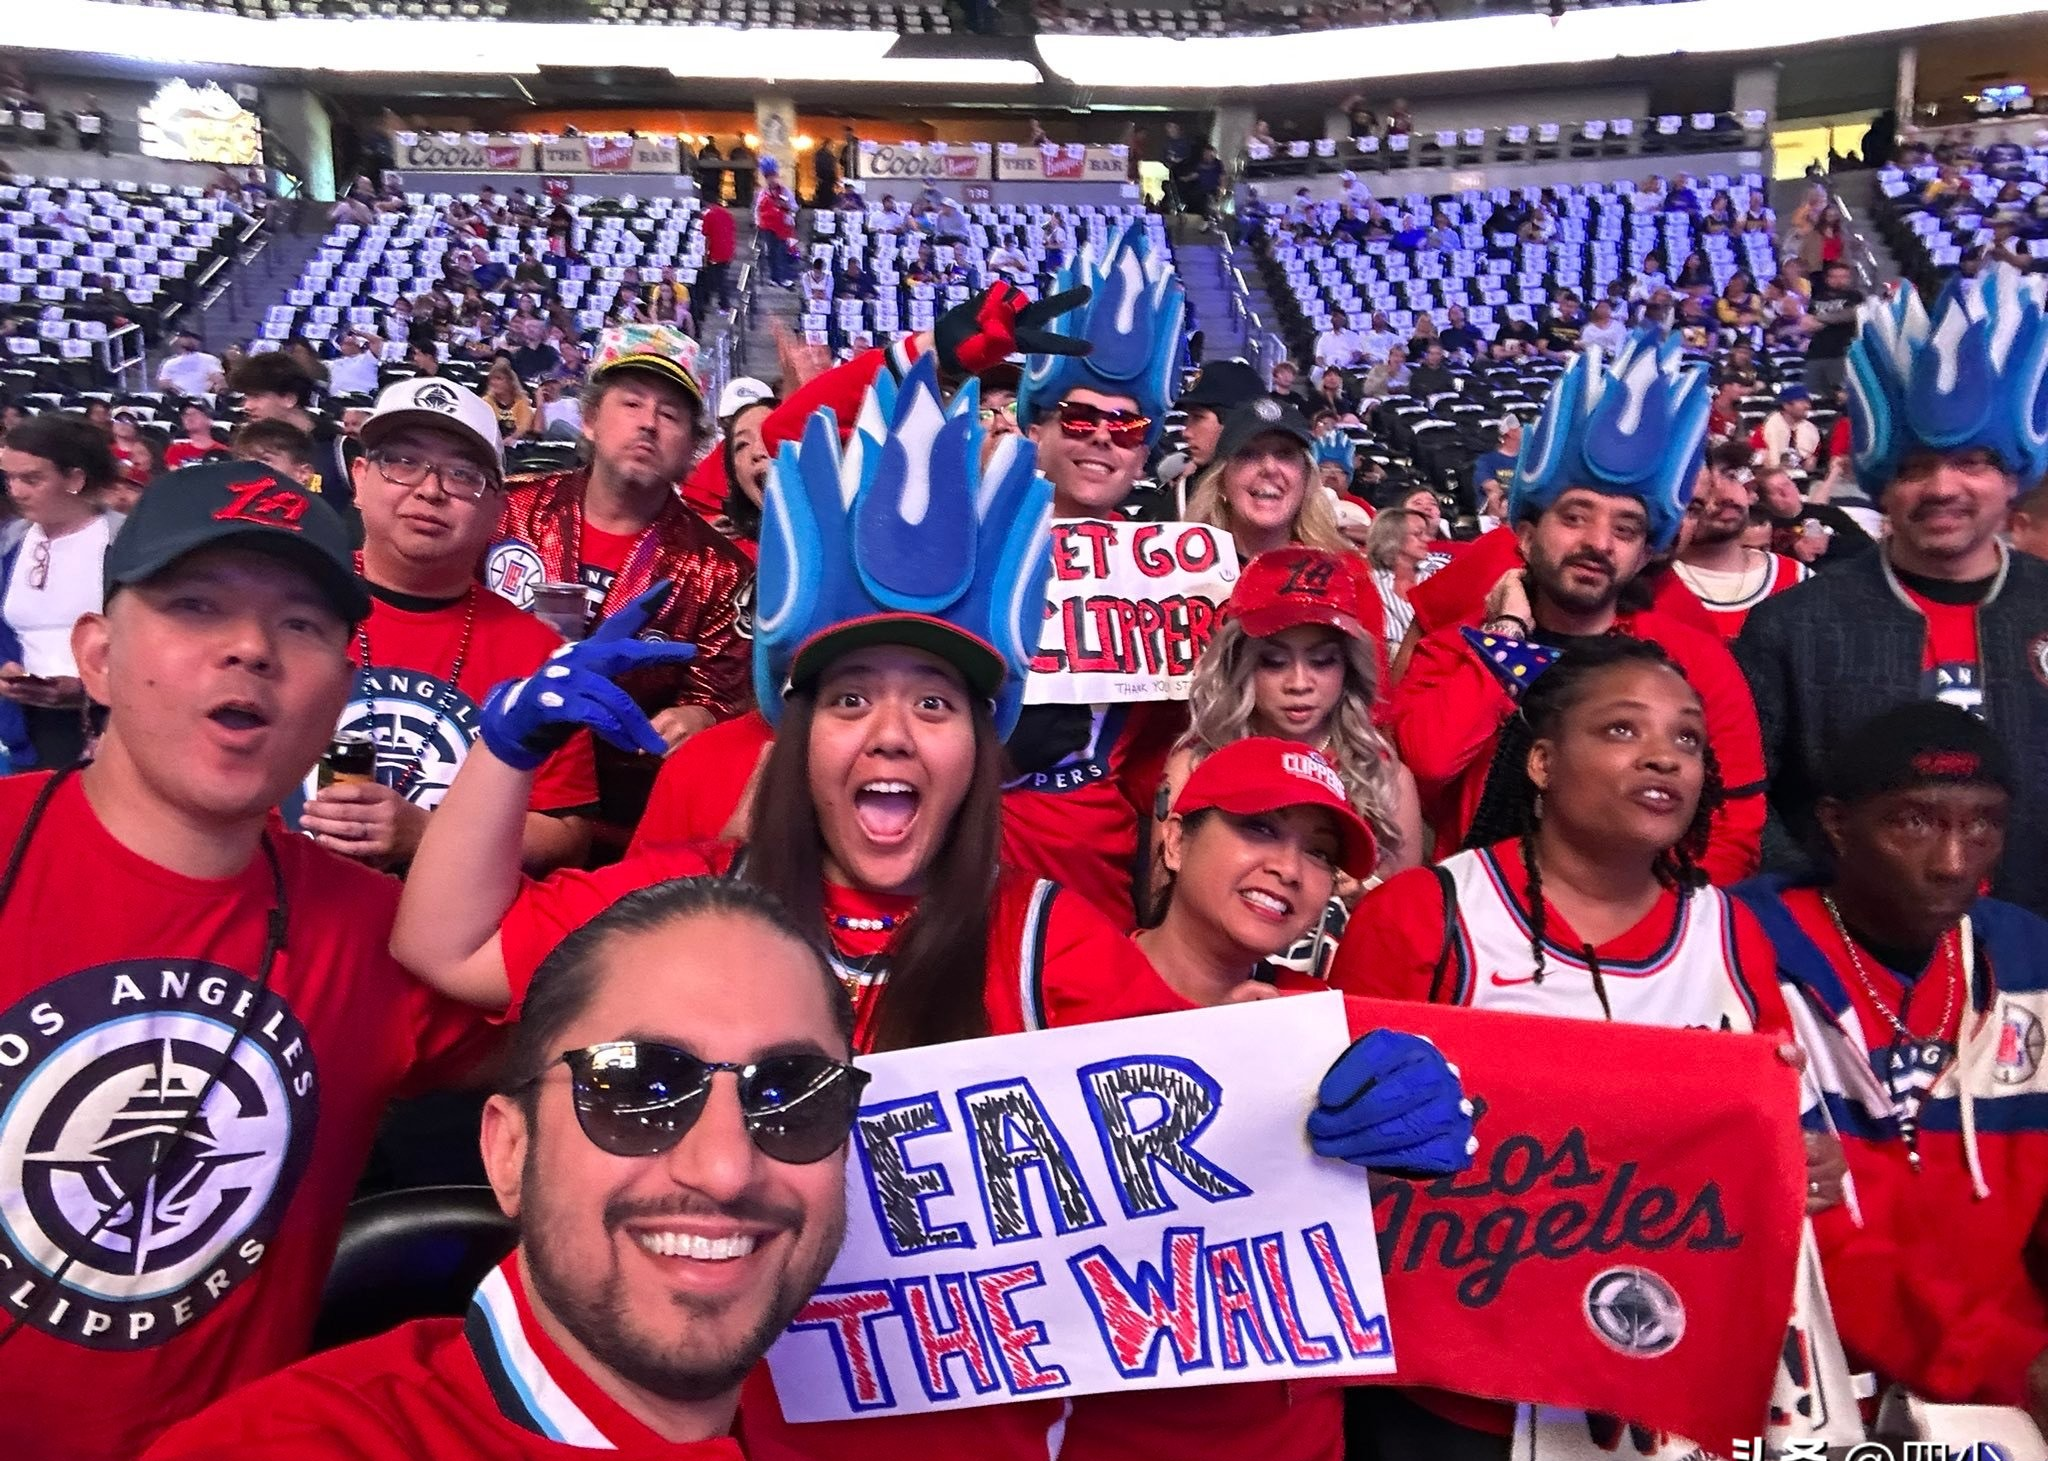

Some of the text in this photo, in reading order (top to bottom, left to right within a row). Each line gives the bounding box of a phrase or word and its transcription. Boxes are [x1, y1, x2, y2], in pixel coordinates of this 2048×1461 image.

[406, 138, 485, 168] Coors
[549, 150, 582, 162] THE
[639, 151, 674, 164] BAR
[869, 146, 946, 176] Coors
[1002, 157, 1036, 171] THE
[1088, 158, 1124, 172] BAR
[1132, 524, 1220, 578] GO
[1114, 681, 1148, 696] THANK
[0, 971, 314, 1098] OS ANGELES
[788, 1222, 1392, 1413] THE WALL
